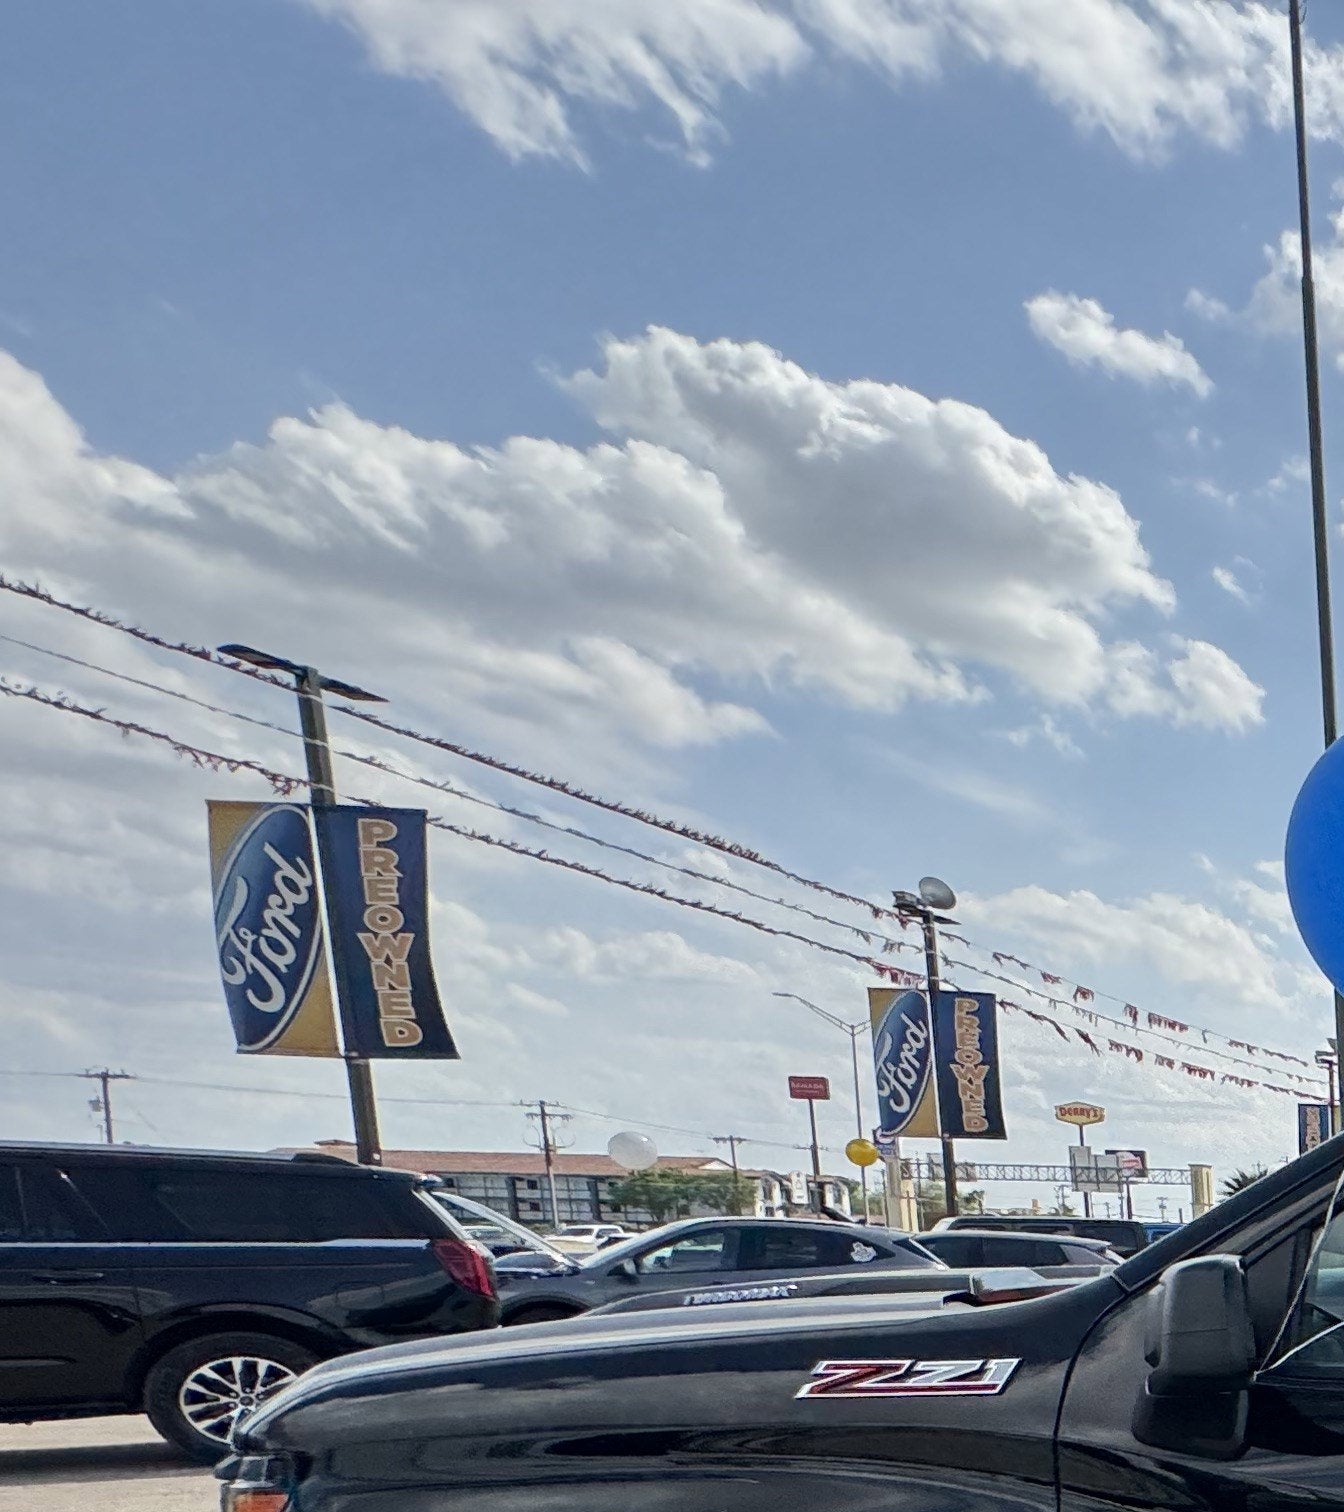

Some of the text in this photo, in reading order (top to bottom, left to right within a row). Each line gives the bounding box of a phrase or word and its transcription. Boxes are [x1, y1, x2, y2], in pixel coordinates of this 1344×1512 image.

[219, 841, 312, 1014] Ford
[357, 818, 424, 1048] PREOWNED
[876, 1012, 929, 1114] Ford
[794, 1358, 1022, 1400] Z71
